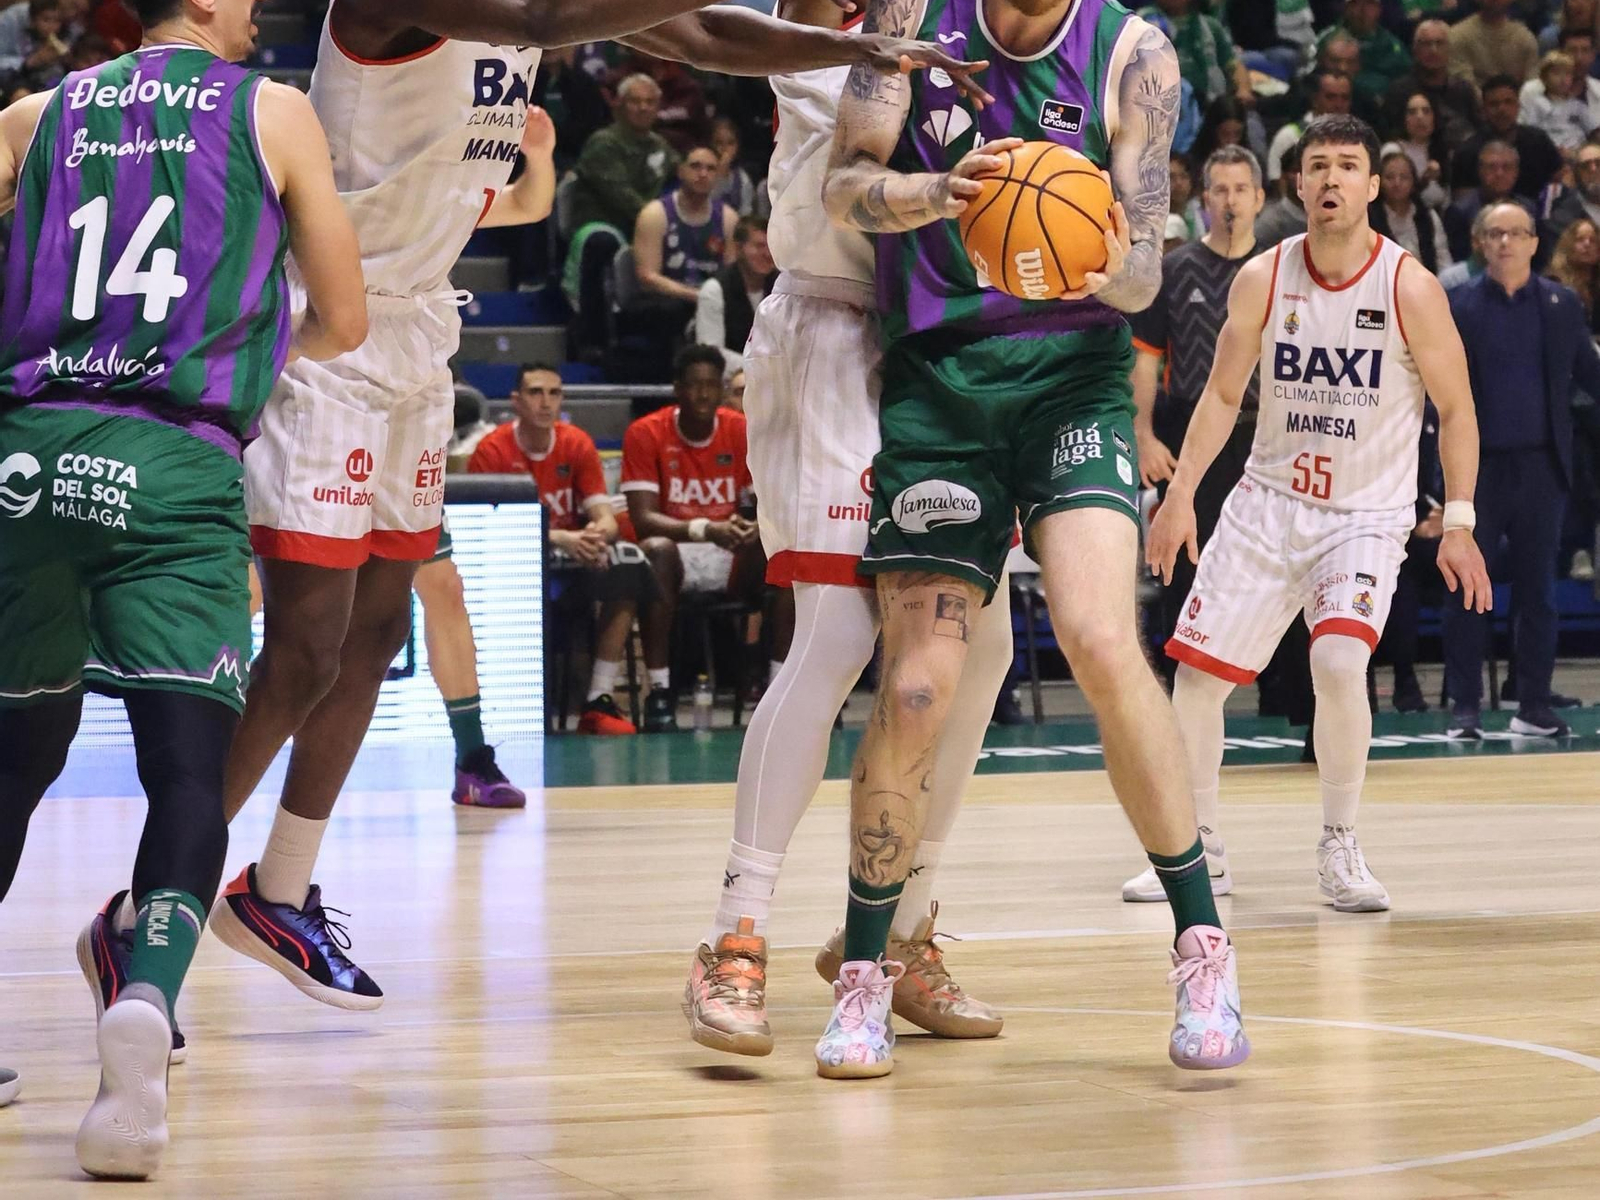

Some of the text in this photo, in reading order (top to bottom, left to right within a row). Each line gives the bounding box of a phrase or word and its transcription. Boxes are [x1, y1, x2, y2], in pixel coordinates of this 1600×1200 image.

[1043, 117, 1078, 131] endesa
[1045, 108, 1062, 119] liga
[68, 194, 188, 323] 14
[1274, 341, 1383, 389] BAXI
[1273, 384, 1380, 407] CLIMATIACIÓN
[56, 453, 138, 489] COSTA
[1052, 443, 1104, 468] laga
[668, 476, 737, 506] BAXI
[1291, 452, 1332, 500] 55
[53, 478, 132, 510] DEL SOL
[544, 488, 573, 517] XI
[896, 485, 977, 524] famadesa
[52, 498, 127, 531] MÁLAGA
